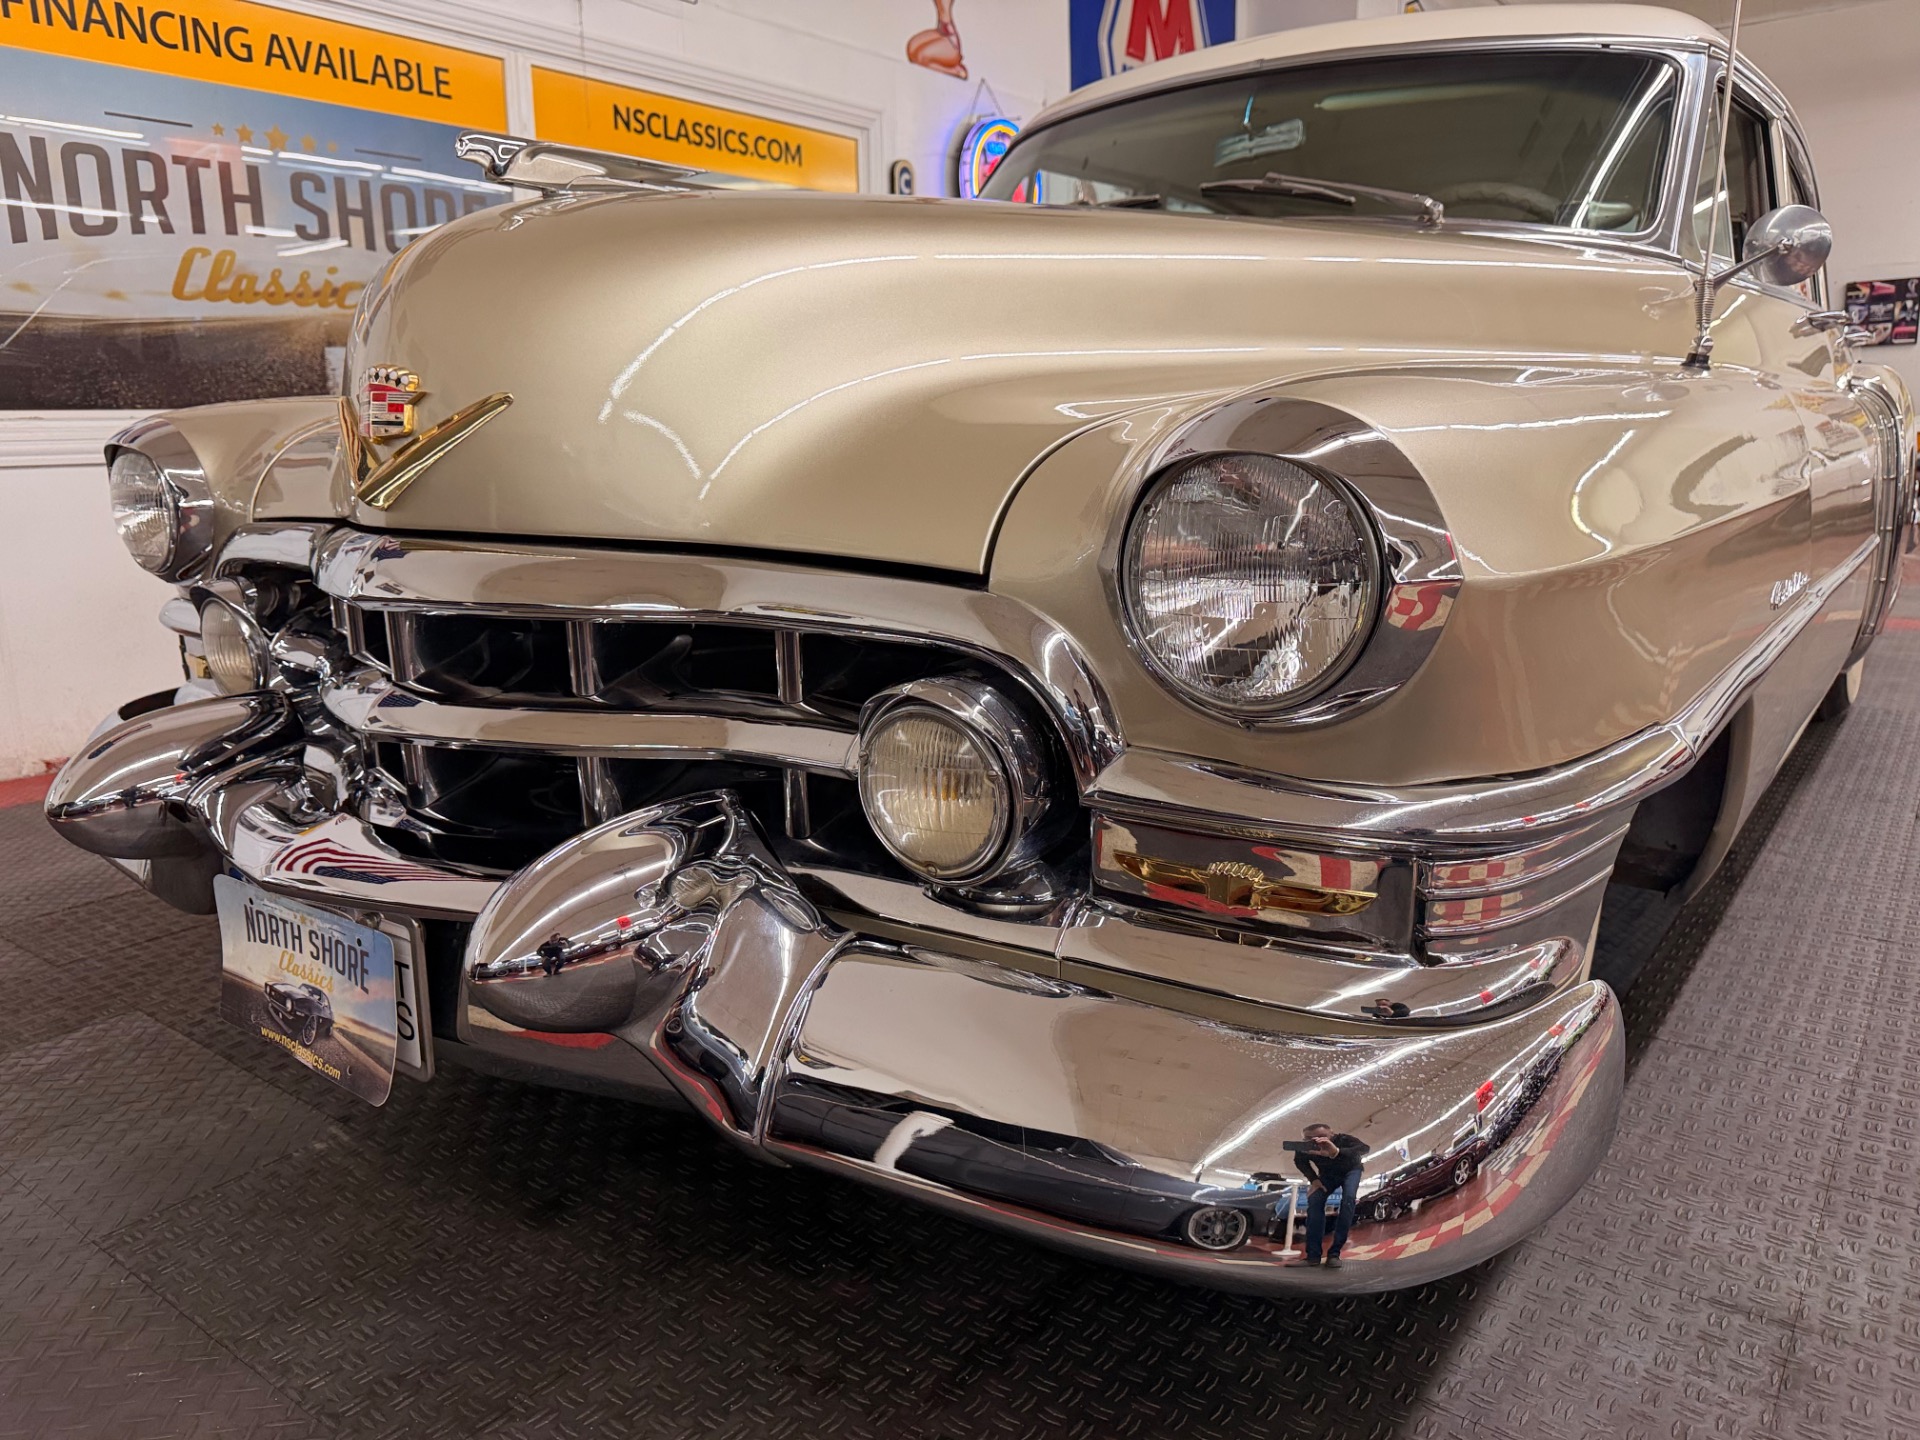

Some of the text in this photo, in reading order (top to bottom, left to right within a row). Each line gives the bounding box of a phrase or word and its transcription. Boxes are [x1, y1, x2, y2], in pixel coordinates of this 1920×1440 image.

[265, 33, 453, 100] AVAILABLE
[613, 104, 803, 167] NSCLASSICS.COM
[0, 132, 267, 244] NORTH
[244, 903, 370, 995] NORTH SHORE
[279, 949, 335, 993] Classics
[261, 1026, 342, 1081] www.nsclassics.com
